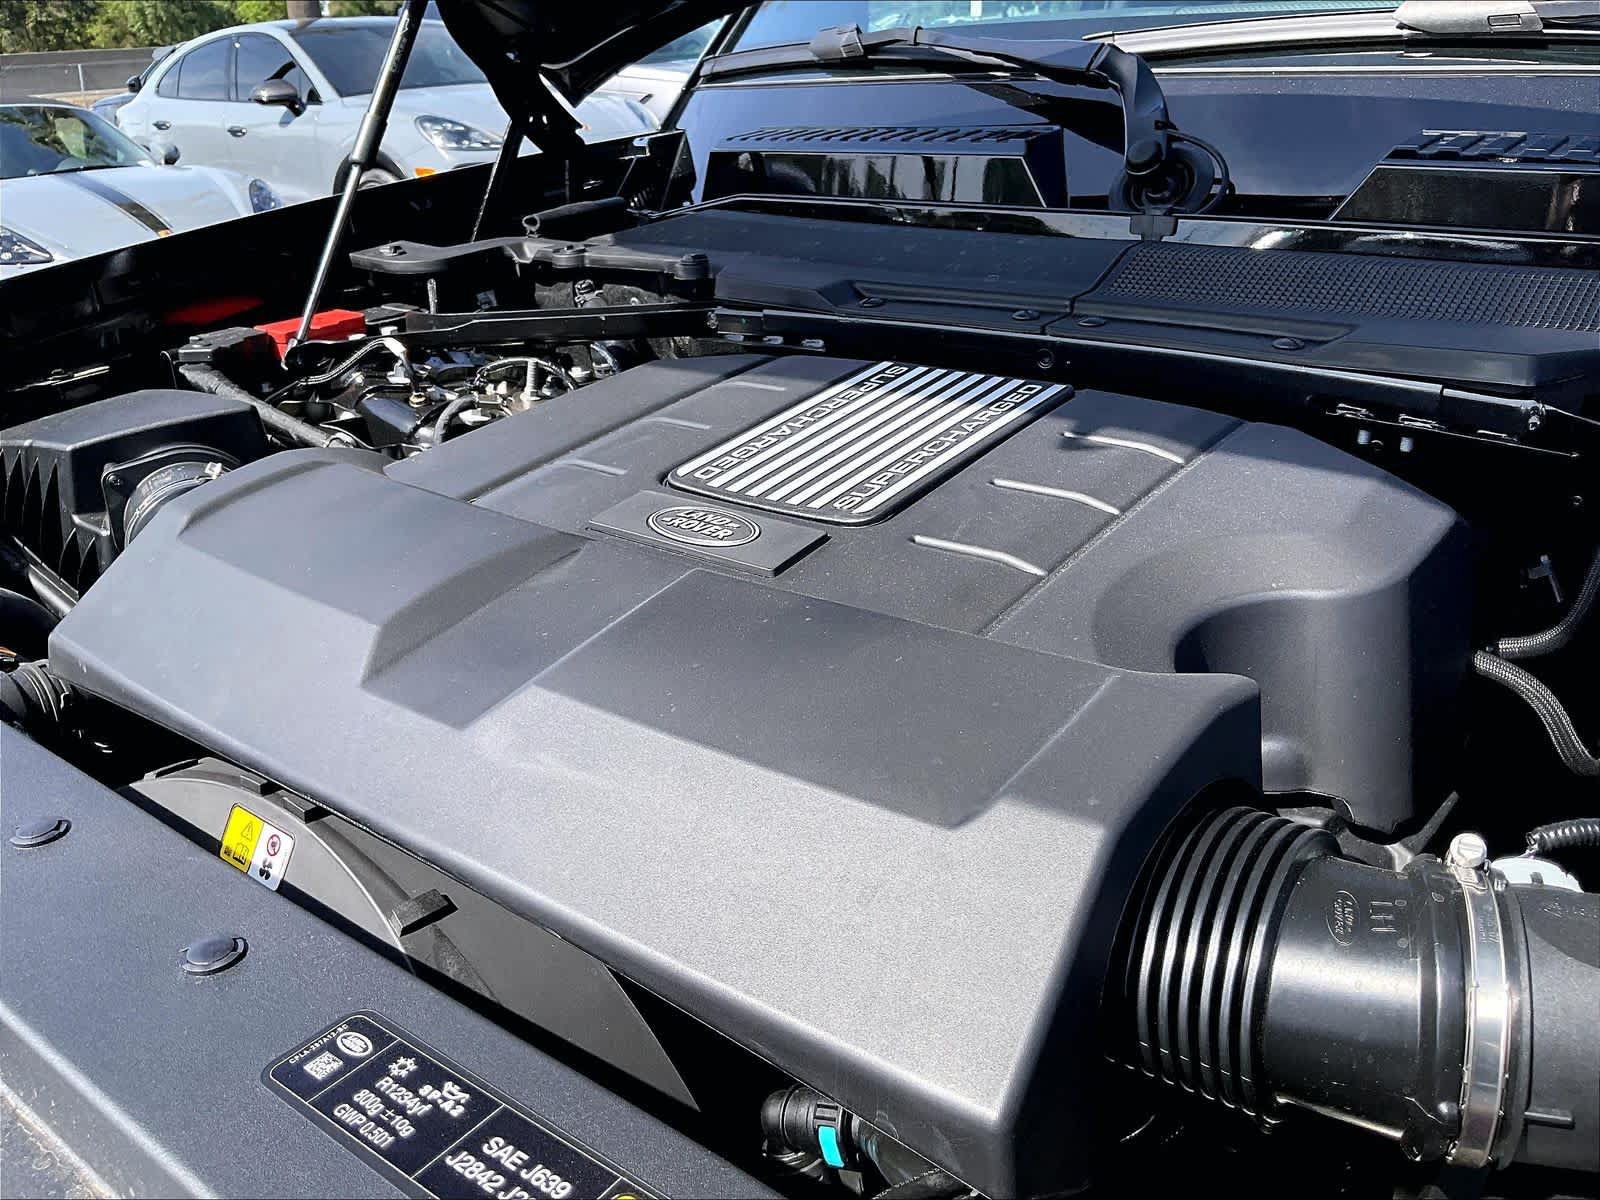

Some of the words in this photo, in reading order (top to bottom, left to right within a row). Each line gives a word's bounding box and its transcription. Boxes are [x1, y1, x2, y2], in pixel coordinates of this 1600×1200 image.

[694, 364, 909, 480] SUPERCHARGED
[834, 383, 1042, 511] SUPERCHARGED
[669, 517, 734, 541] ROVER
[676, 509, 727, 529] LAND
[353, 1089, 385, 1117] 800g
[375, 1076, 433, 1117] R1234yf
[333, 1103, 366, 1127] GWP
[359, 1121, 396, 1148] 0.501
[445, 1150, 505, 1194] J2842
[482, 1136, 529, 1171] SAE
[520, 1164, 572, 1199] J639
